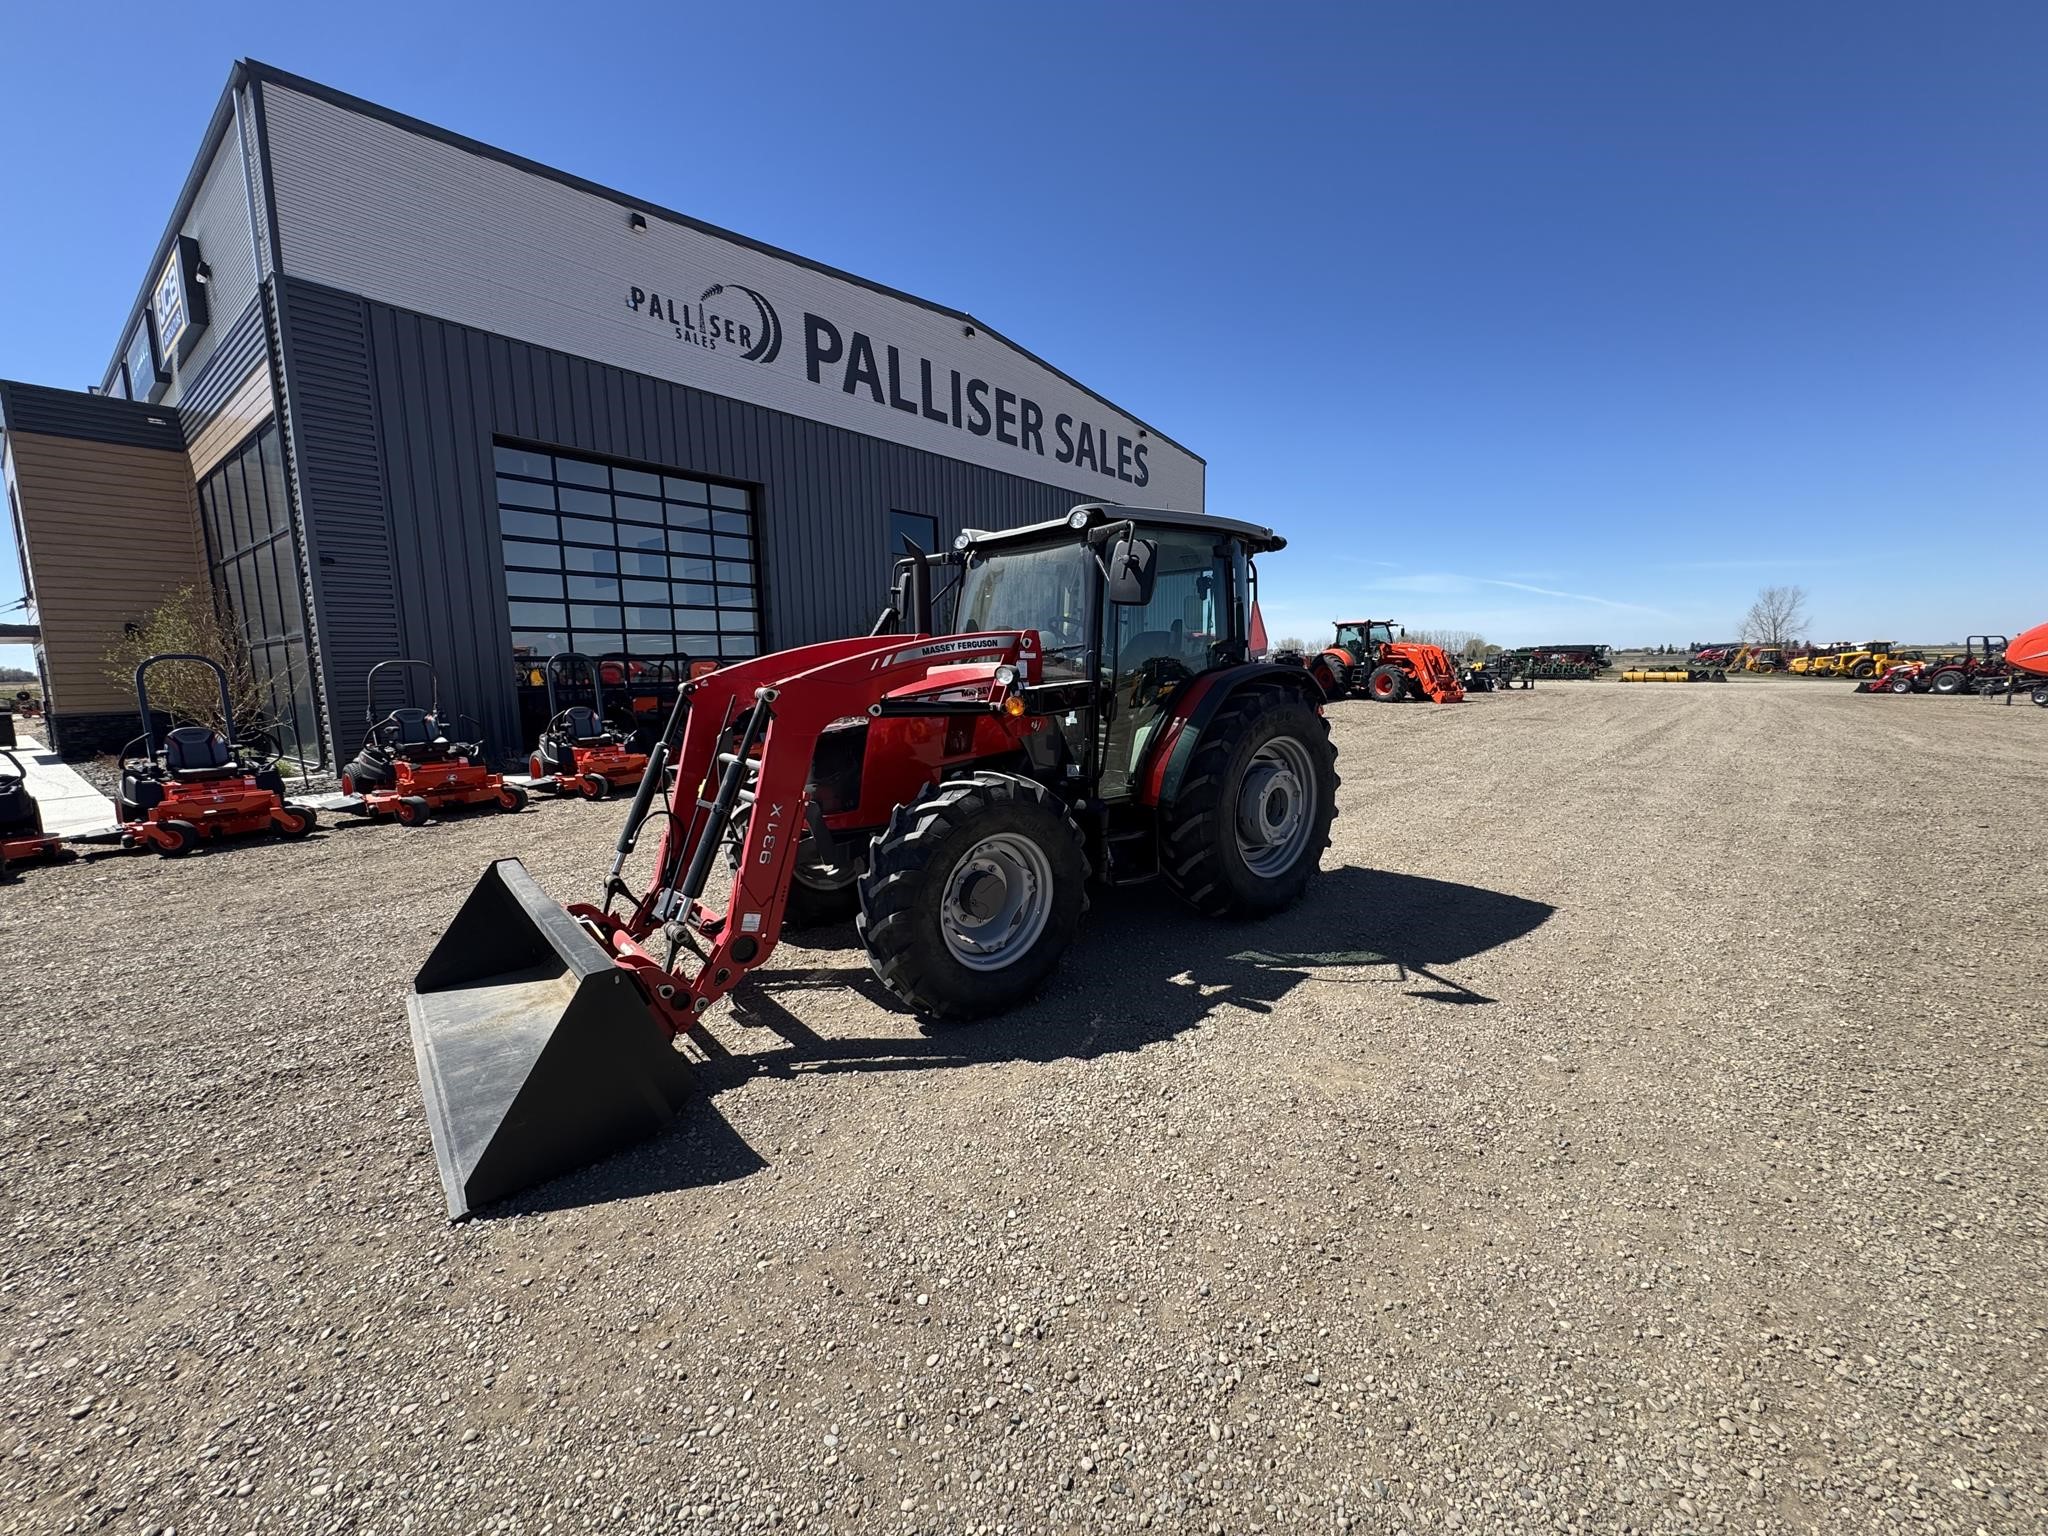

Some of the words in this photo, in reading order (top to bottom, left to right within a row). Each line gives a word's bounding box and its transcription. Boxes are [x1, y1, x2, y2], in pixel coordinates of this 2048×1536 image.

[630, 286, 752, 350] PALLISER
[675, 327, 716, 350] SALES
[803, 311, 1044, 456] PALLISER
[1054, 413, 1149, 487] SALES
[922, 643, 956, 656] MASSEY
[957, 639, 998, 650] FERGUSON
